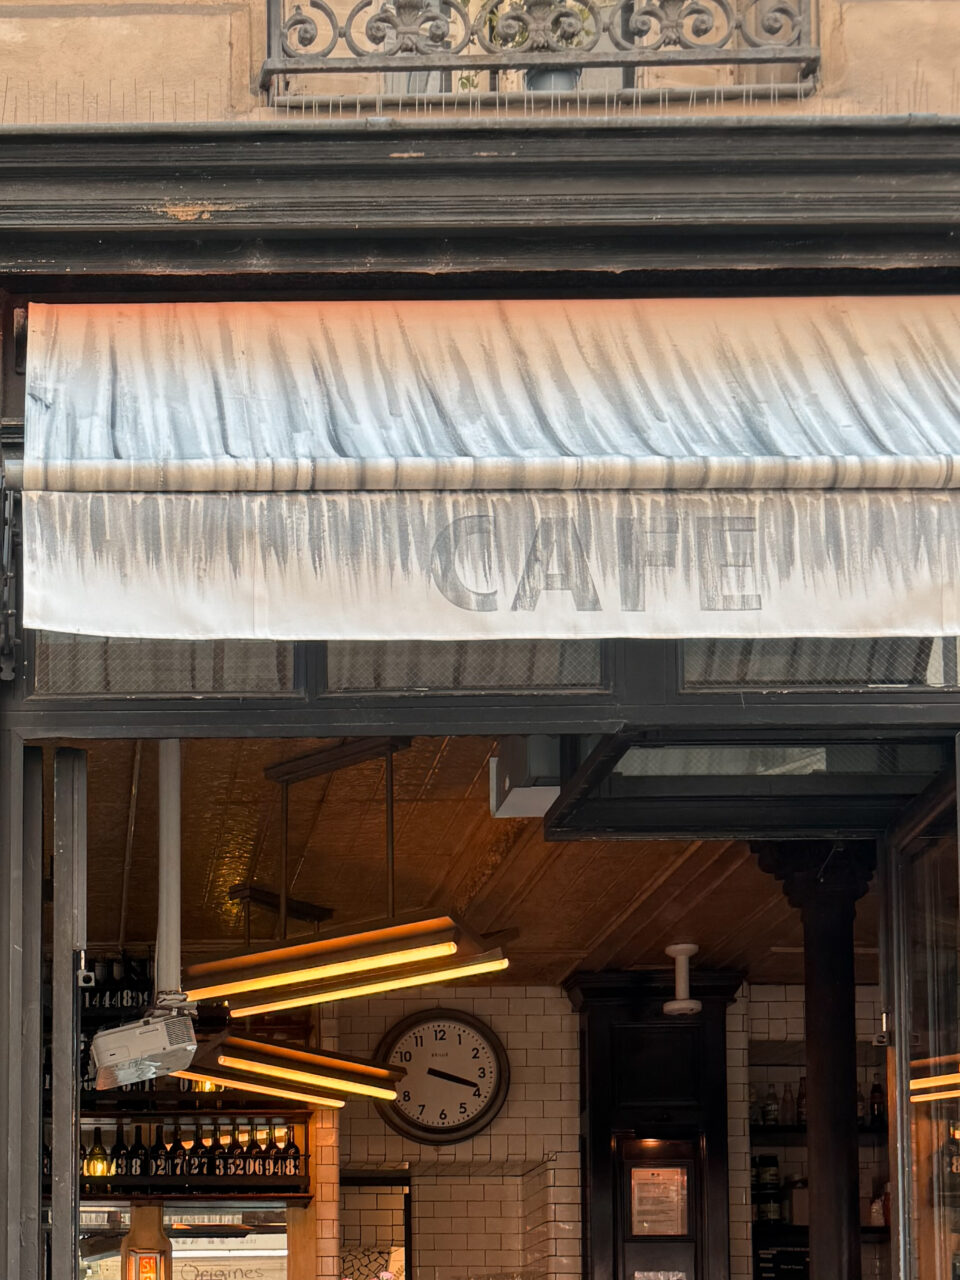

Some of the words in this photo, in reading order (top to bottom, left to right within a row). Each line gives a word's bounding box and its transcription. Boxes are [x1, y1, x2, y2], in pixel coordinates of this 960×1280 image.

[414, 1036, 424, 1047] 11
[457, 1034, 462, 1045] 1
[434, 1030, 446, 1041] 12
[399, 1051, 412, 1062] 10
[472, 1048, 480, 1059] 2
[478, 1067, 486, 1078] 3
[403, 1091, 411, 1102] 8
[472, 1087, 482, 1098] 4
[418, 1104, 426, 1115] 7
[459, 1103, 467, 1114] 5
[439, 1109, 447, 1120] 6
